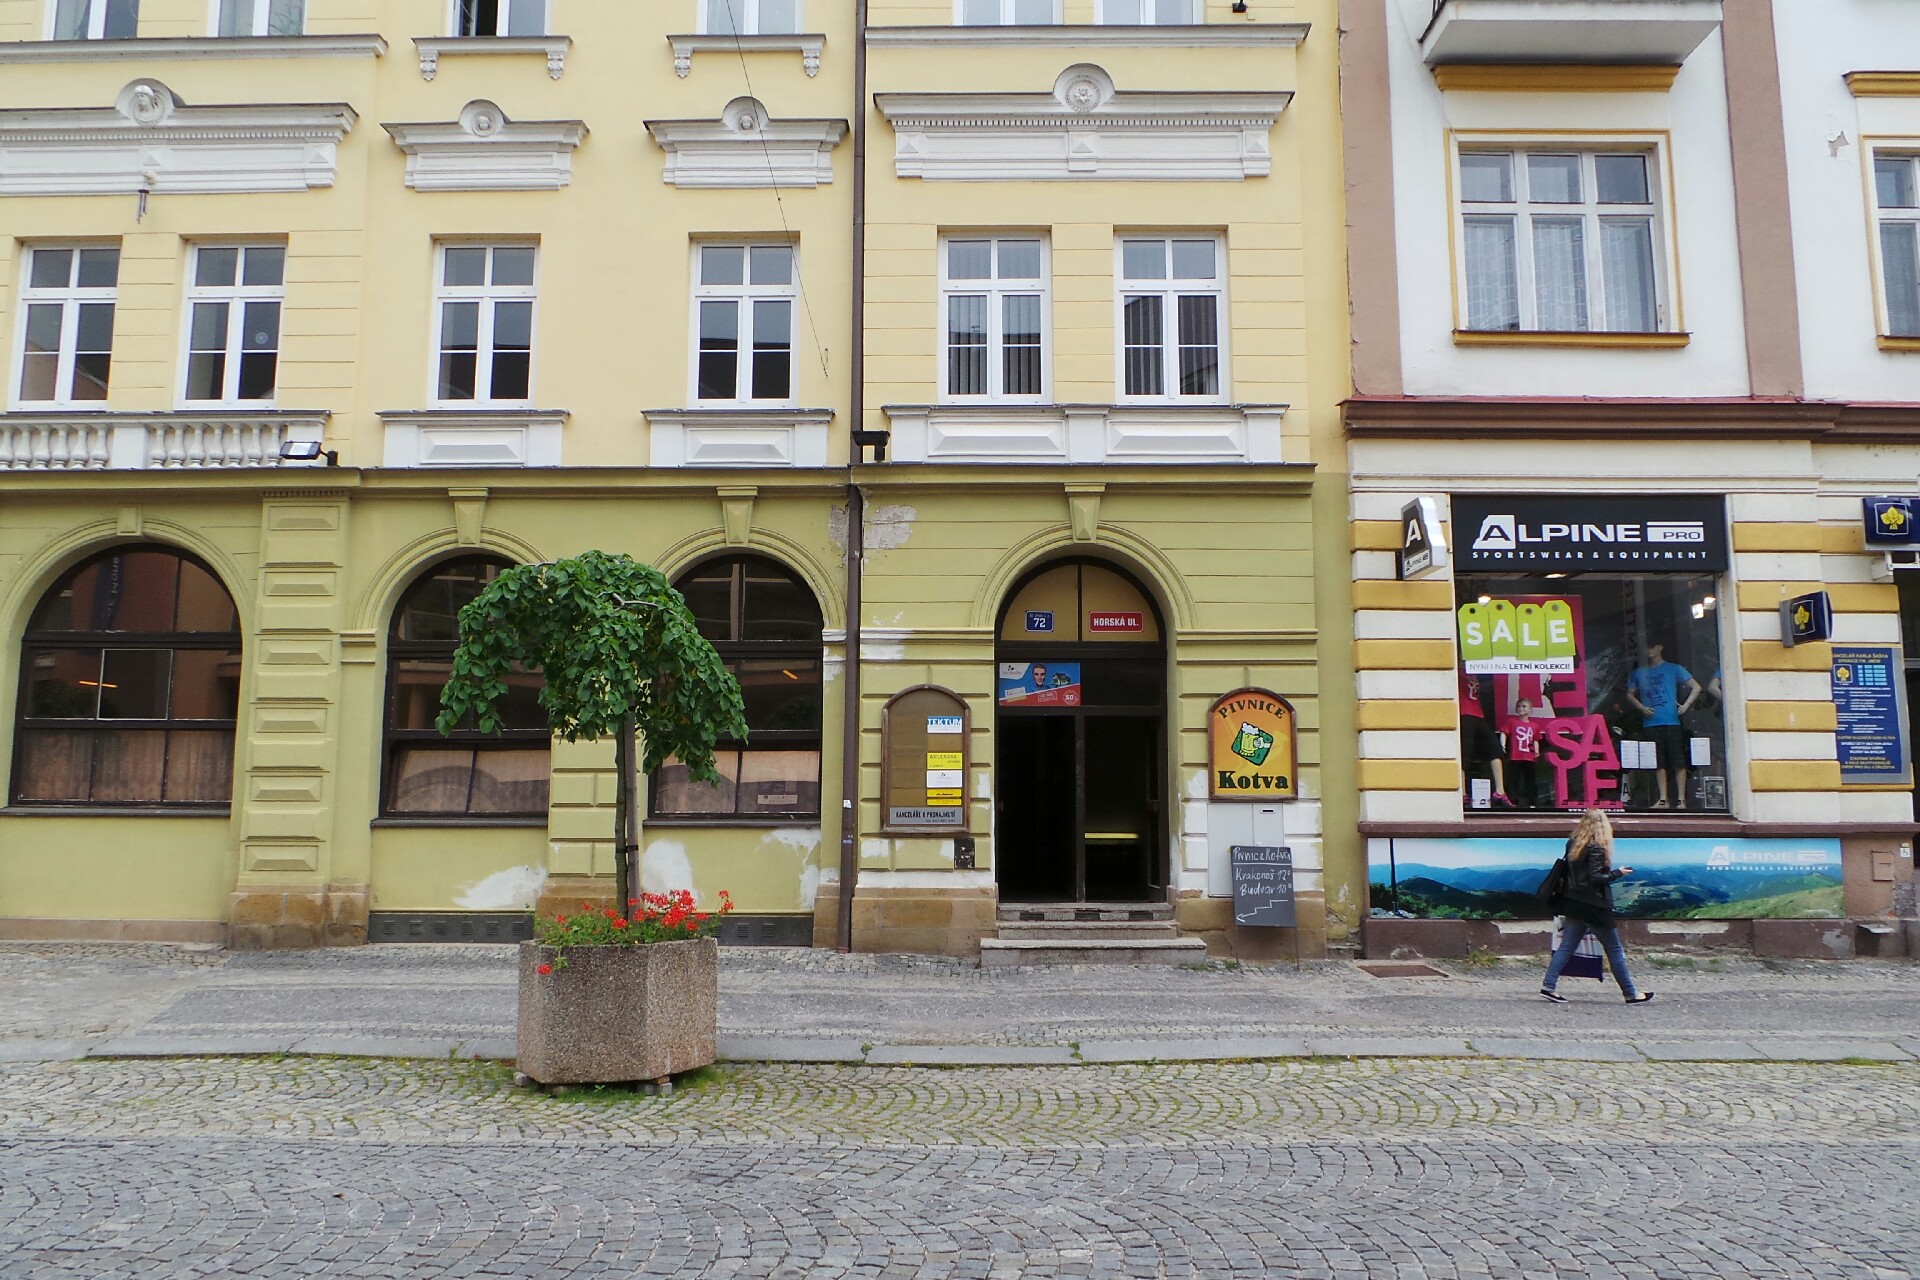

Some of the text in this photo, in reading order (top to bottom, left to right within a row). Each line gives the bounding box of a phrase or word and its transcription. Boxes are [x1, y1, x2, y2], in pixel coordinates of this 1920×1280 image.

[1405, 518, 1422, 548] A
[1473, 515, 1641, 549] ALPINE
[1472, 551, 1708, 559] SPORTSWEAR & EQUIPMENT
[1033, 617, 1046, 628] 72
[1093, 616, 1139, 627] HORSKÁ UL.
[1466, 619, 1569, 646] SALE
[1469, 662, 1489, 670] NYNÍ
[1509, 662, 1533, 670] LETNÍ
[1218, 700, 1286, 719] PIVNICE
[928, 718, 962, 726] TEKTUM
[1217, 770, 1289, 789] Kotva
[896, 809, 921, 818] KANCELÁŘE
[926, 809, 956, 818] PRONAJMUTÍ
[1233, 847, 1265, 861] Pivnice
[1706, 846, 1796, 865] ALPINE
[1235, 868, 1275, 880] Krakonoš
[1240, 882, 1276, 896] Budvar
